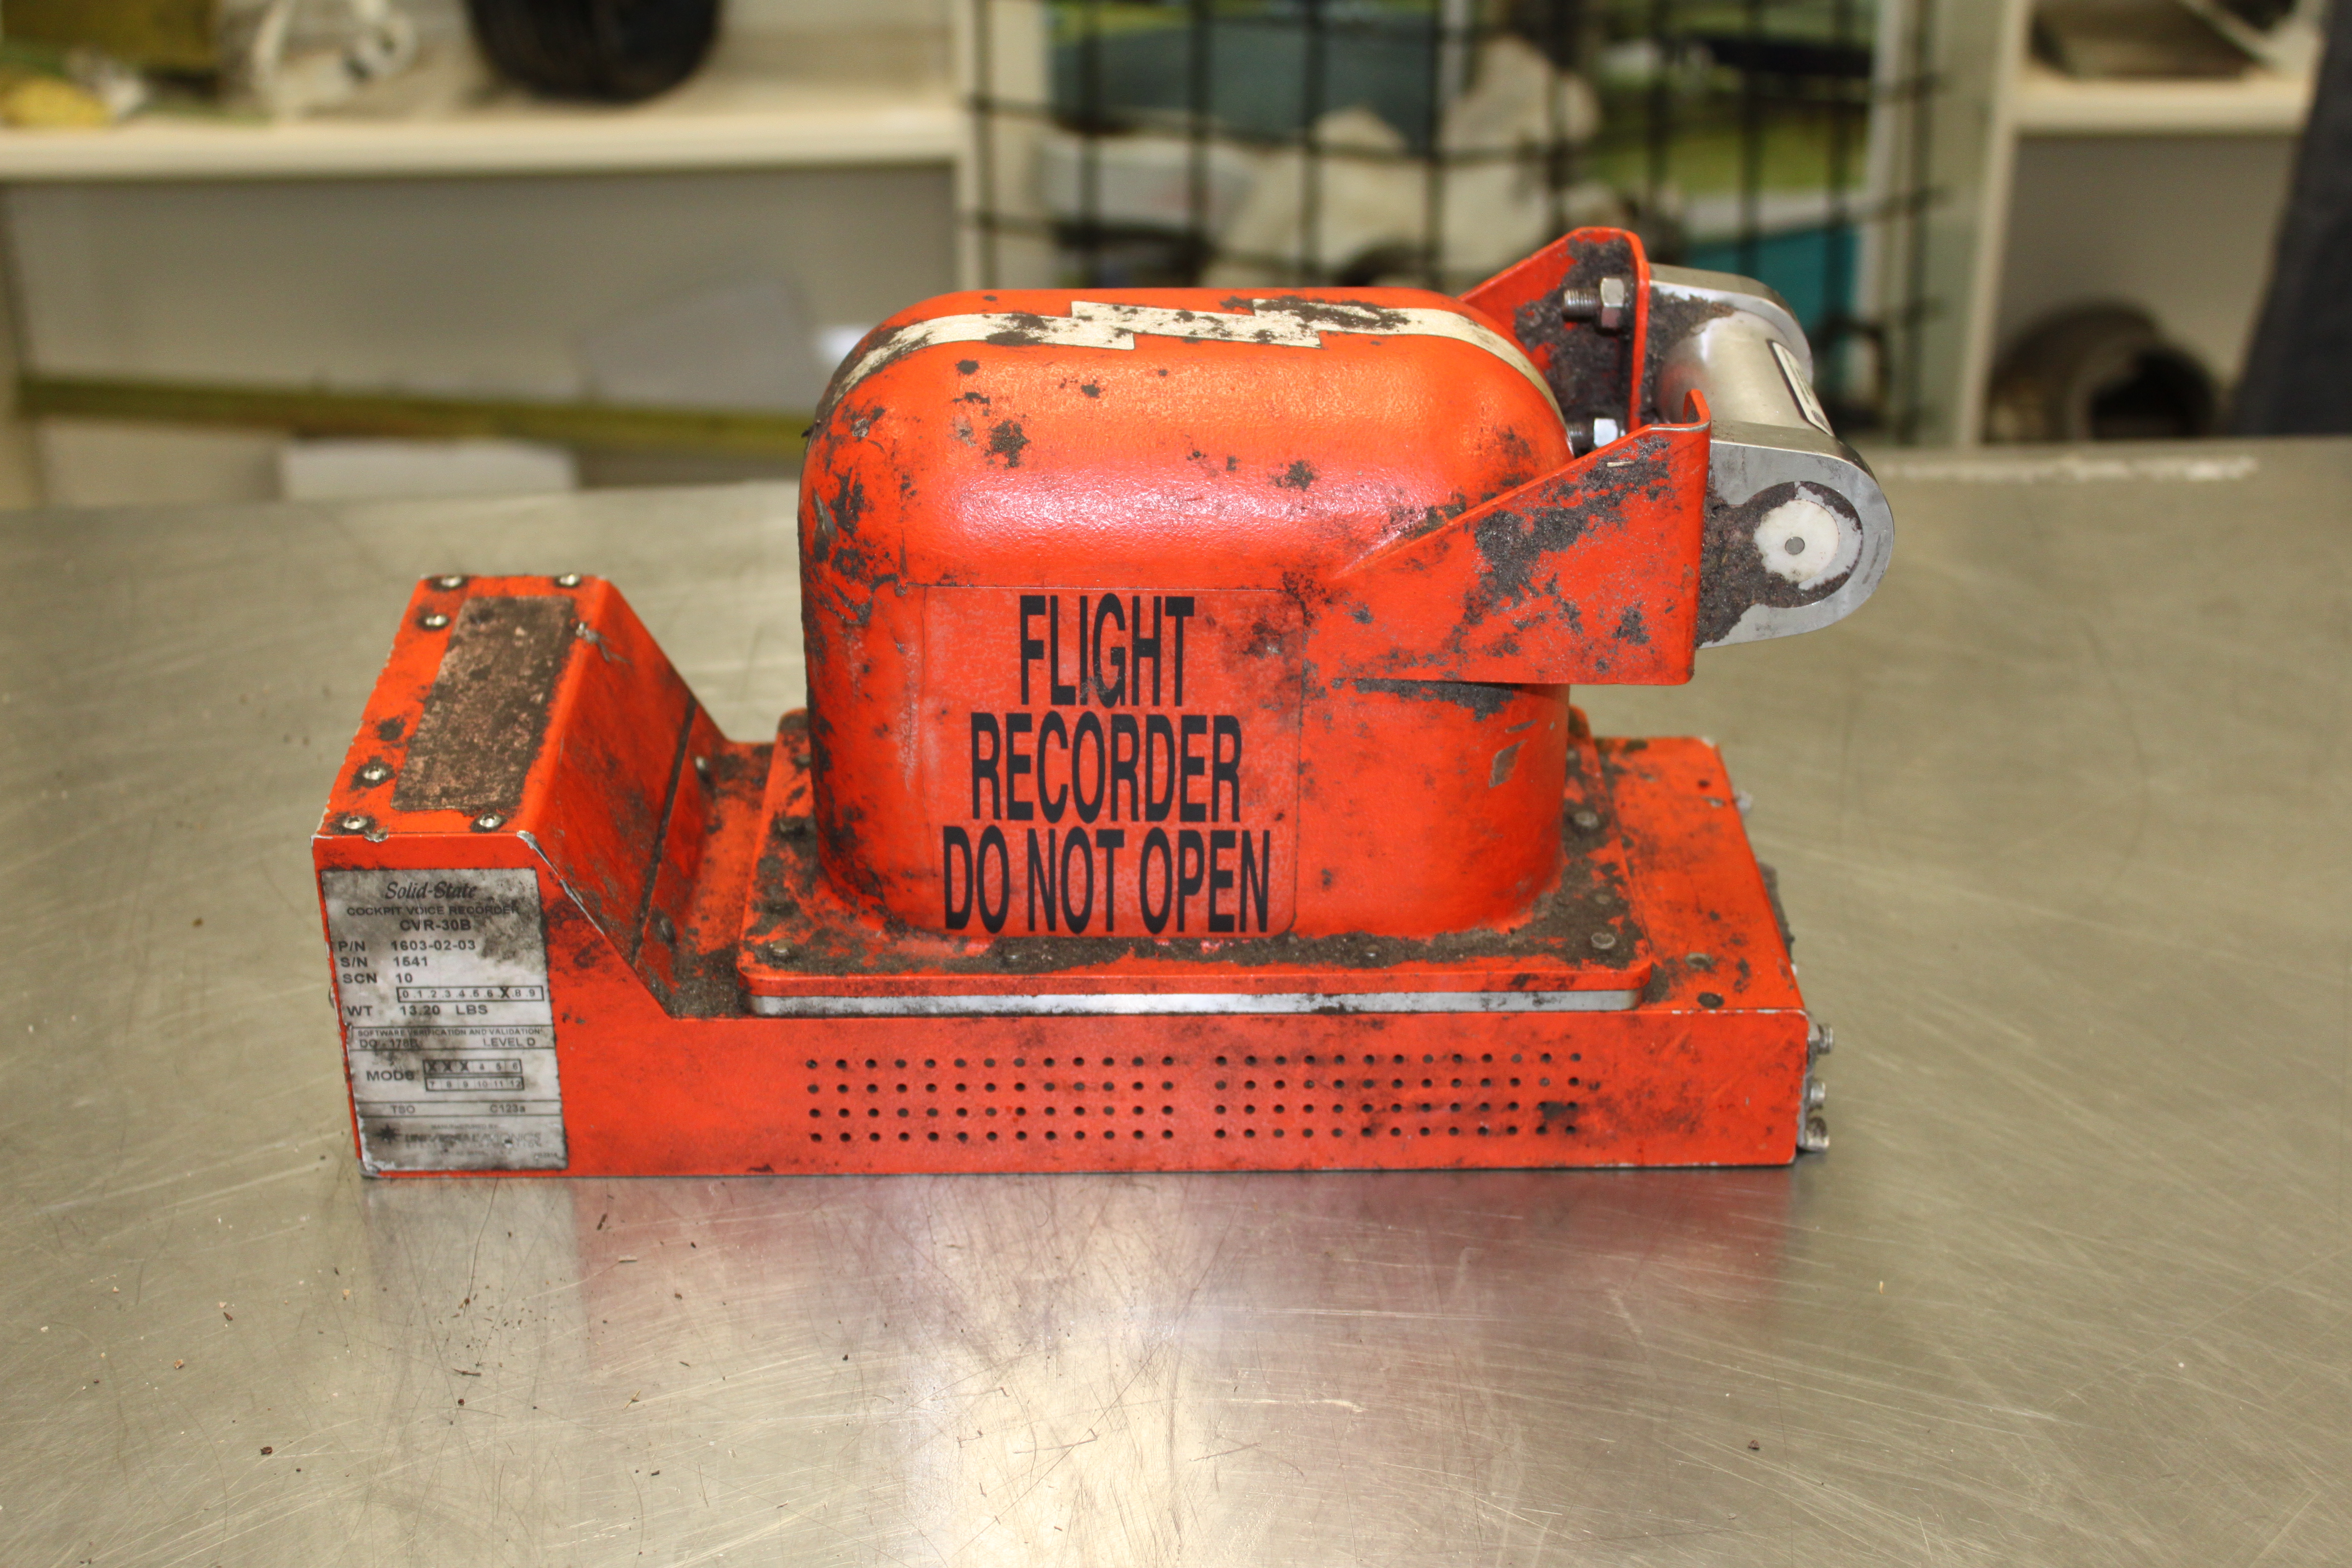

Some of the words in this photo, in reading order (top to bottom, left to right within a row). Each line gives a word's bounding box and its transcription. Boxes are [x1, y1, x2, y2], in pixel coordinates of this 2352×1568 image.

[1020, 593, 1195, 708] FLIGHT
[971, 711, 1242, 824] RECORDER
[943, 825, 1010, 933] DO
[1027, 826, 1125, 934] NOT
[1140, 827, 1270, 933] OPEN
[385, 881, 478, 899] Solid-State
[347, 907, 401, 916] COCKPIT
[407, 906, 444, 915] VOICE
[449, 905, 520, 915] RECORDER
[399, 919, 471, 931] CVR-30B
[339, 941, 366, 951] P/N
[391, 940, 476, 951] 1603-02-03
[341, 957, 368, 968] S/N
[343, 973, 377, 984] SCN
[396, 973, 413, 983] 10
[346, 1005, 373, 1016] WT
[399, 1005, 441, 1016] 13.20
[455, 1004, 488, 1015] LBS
[357, 1029, 404, 1038] SOFTWARE
[489, 1027, 540, 1035] VALIDATION
[483, 1037, 523, 1047] LEVEL
[527, 1037, 536, 1046] D
[390, 1105, 416, 1115] TSO
[489, 1104, 526, 1113] C123a
